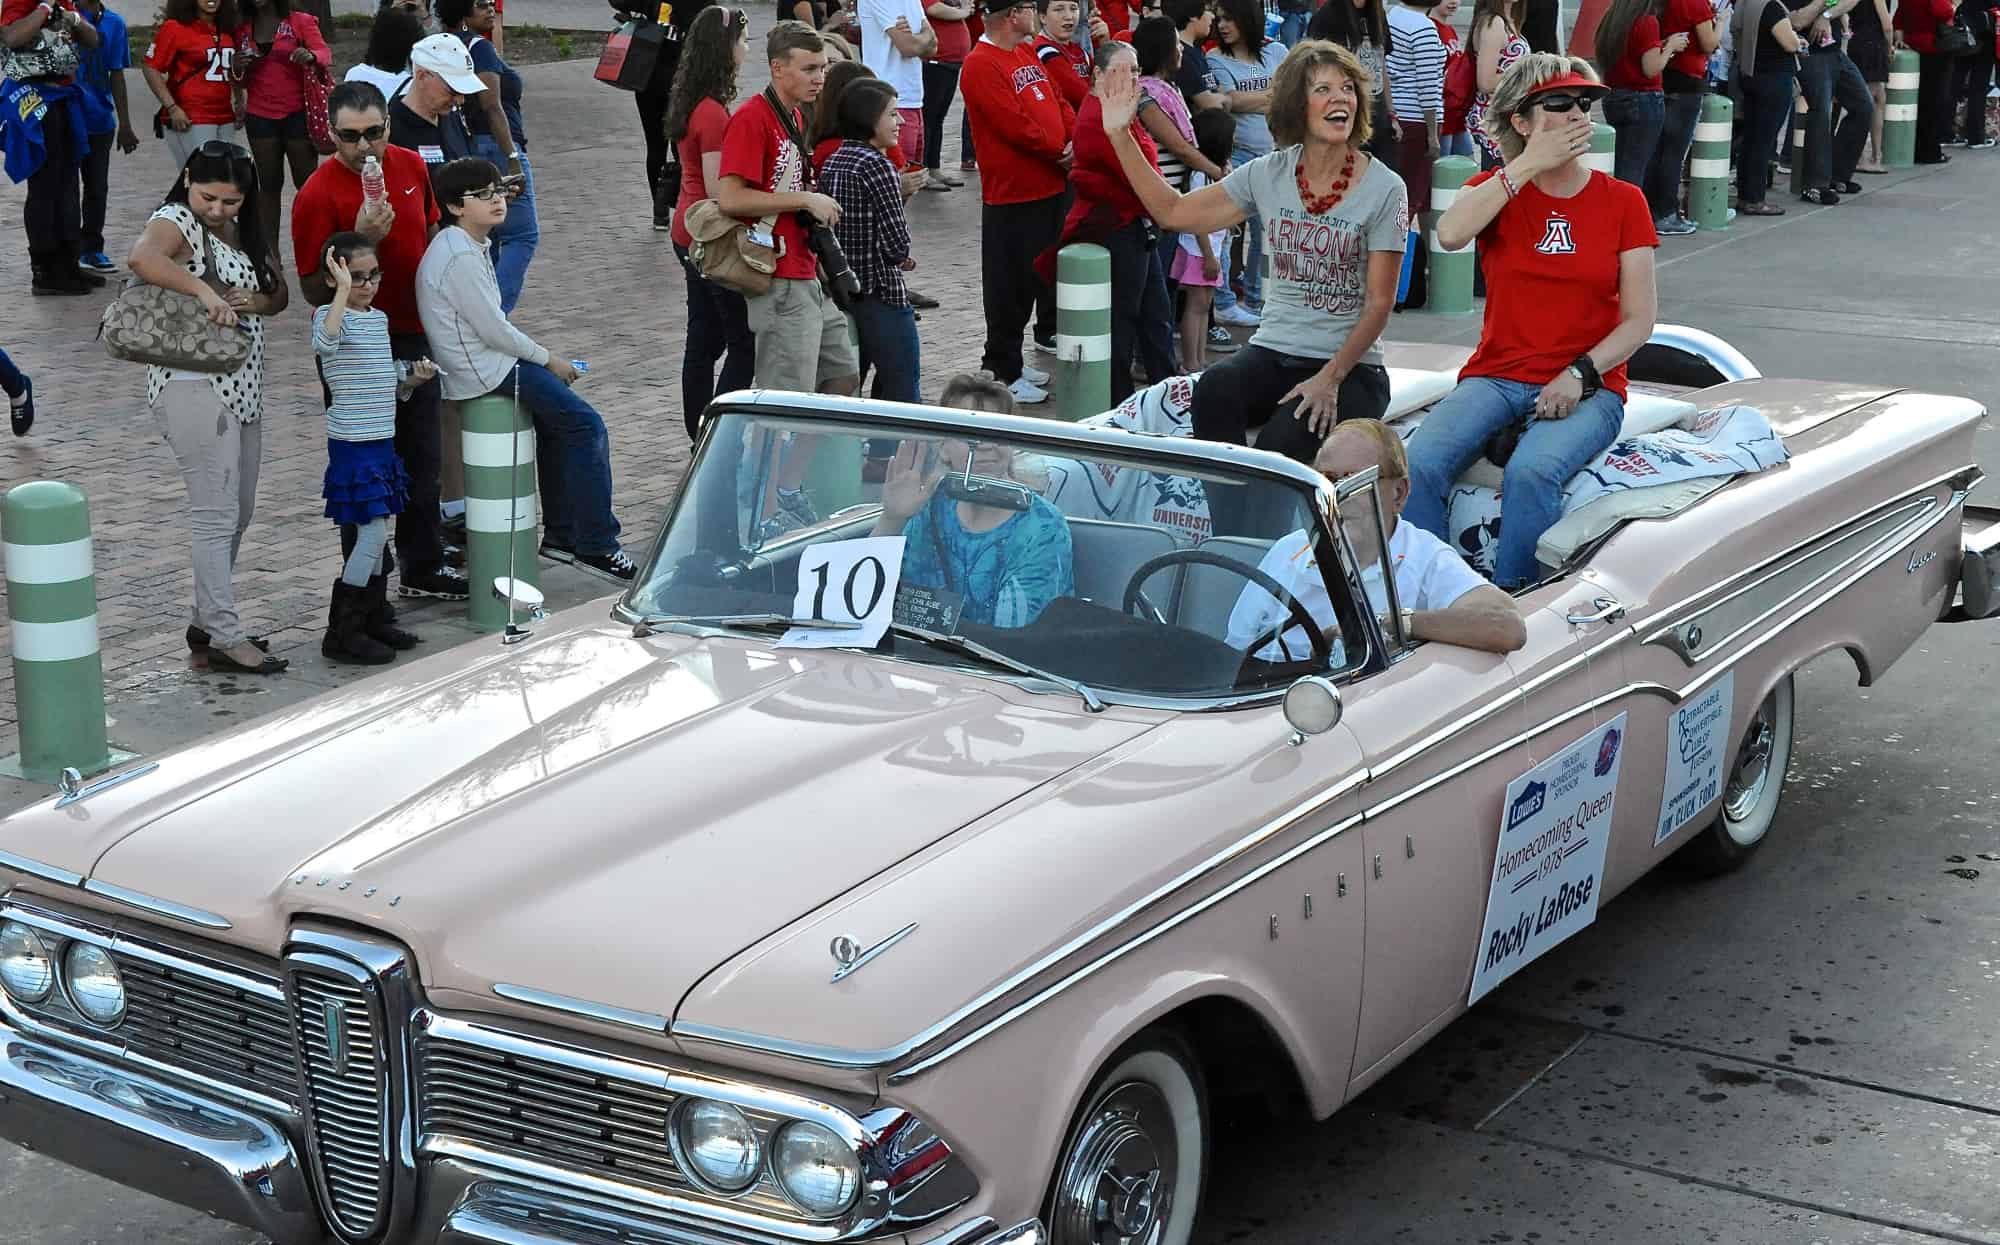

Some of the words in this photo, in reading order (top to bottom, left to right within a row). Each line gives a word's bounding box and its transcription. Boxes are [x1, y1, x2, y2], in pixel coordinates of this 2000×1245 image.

[1269, 218, 1362, 263] ARIZONA
[1534, 218, 1576, 254] A
[1274, 251, 1361, 290] WILDCATS
[810, 556, 886, 620] 10
[1675, 796, 1696, 826] CLICK
[1699, 780, 1716, 808] FORD
[1497, 812, 1572, 882] Homecoming
[1576, 791, 1612, 830] Queen
[1537, 847, 1563, 881] 1978
[1483, 911, 1535, 973] Rocky
[1535, 873, 1594, 937] LaRose
